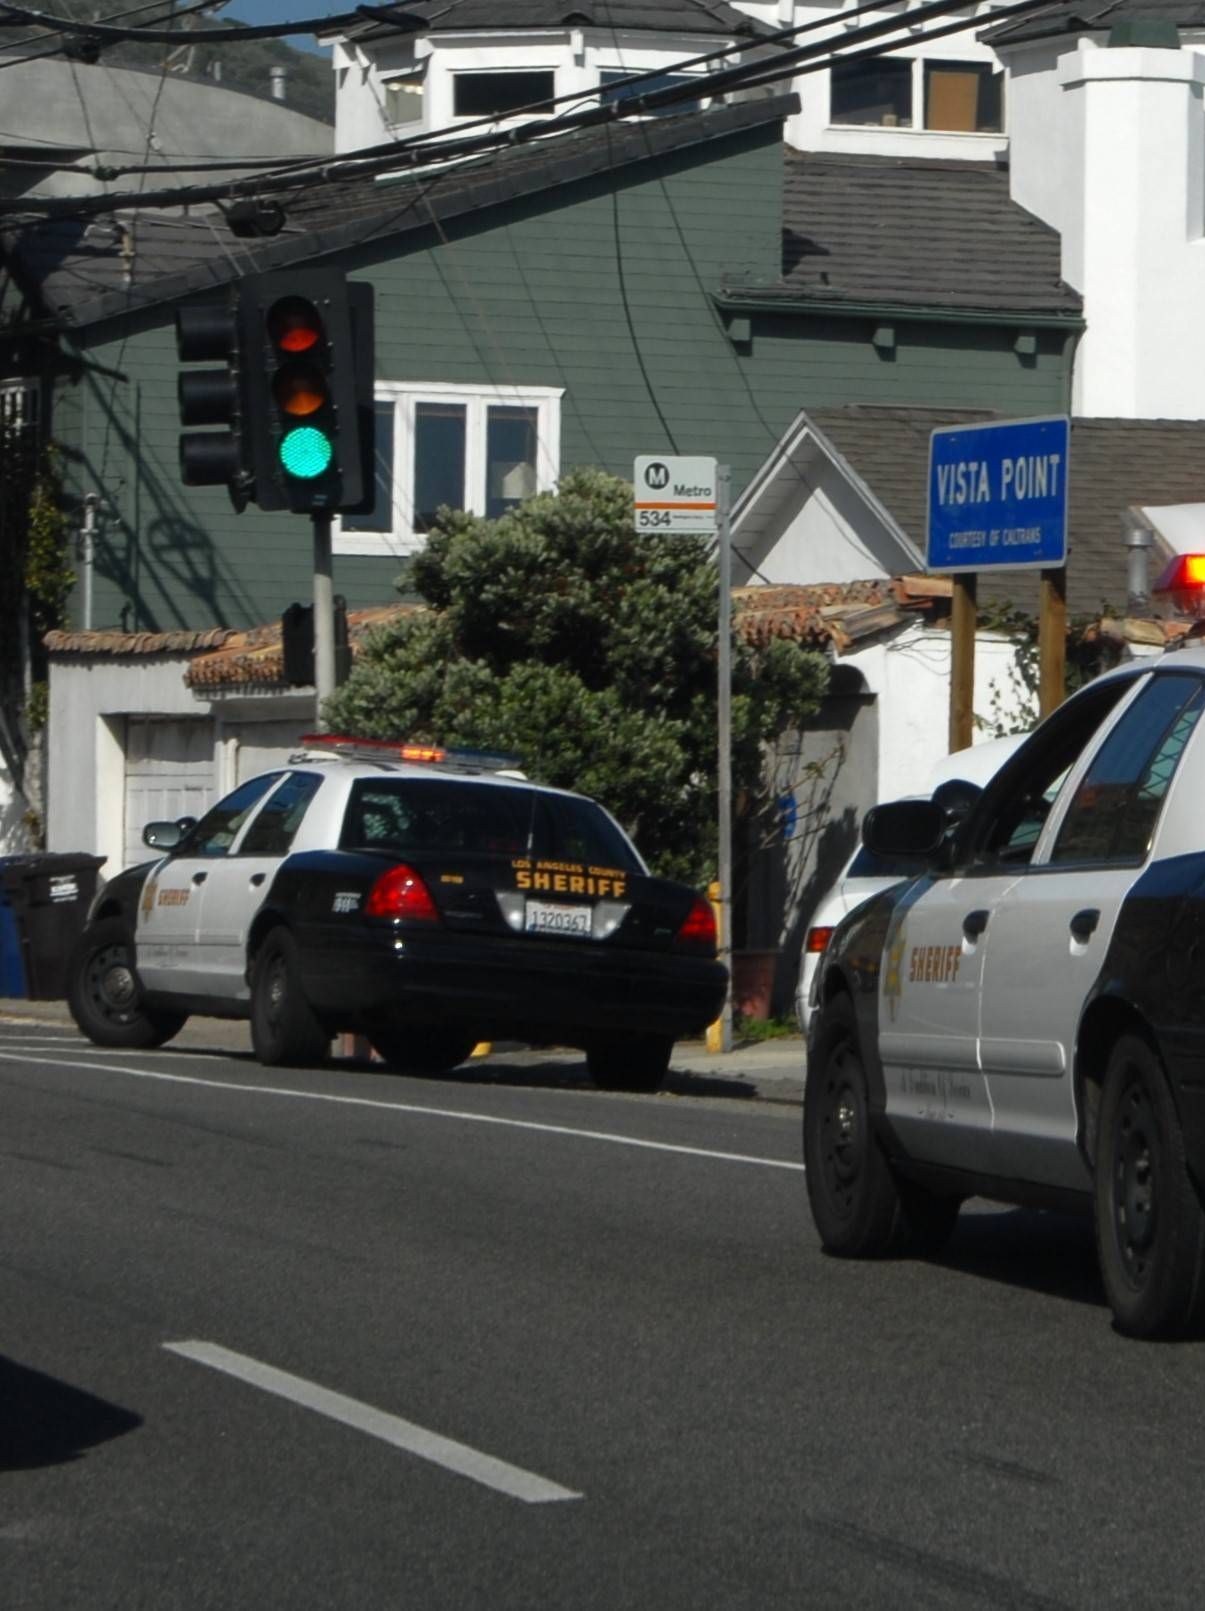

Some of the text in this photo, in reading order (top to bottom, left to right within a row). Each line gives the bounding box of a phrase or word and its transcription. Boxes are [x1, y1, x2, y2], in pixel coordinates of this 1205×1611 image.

[647, 465, 668, 488] M
[937, 454, 1060, 505] VISTA POINT
[673, 484, 712, 497] Metro
[640, 510, 671, 526] 534
[512, 859, 626, 879] LOS ANGELES COUNTY
[516, 871, 626, 898] SHERIFF
[909, 945, 963, 982] SHERIFF
